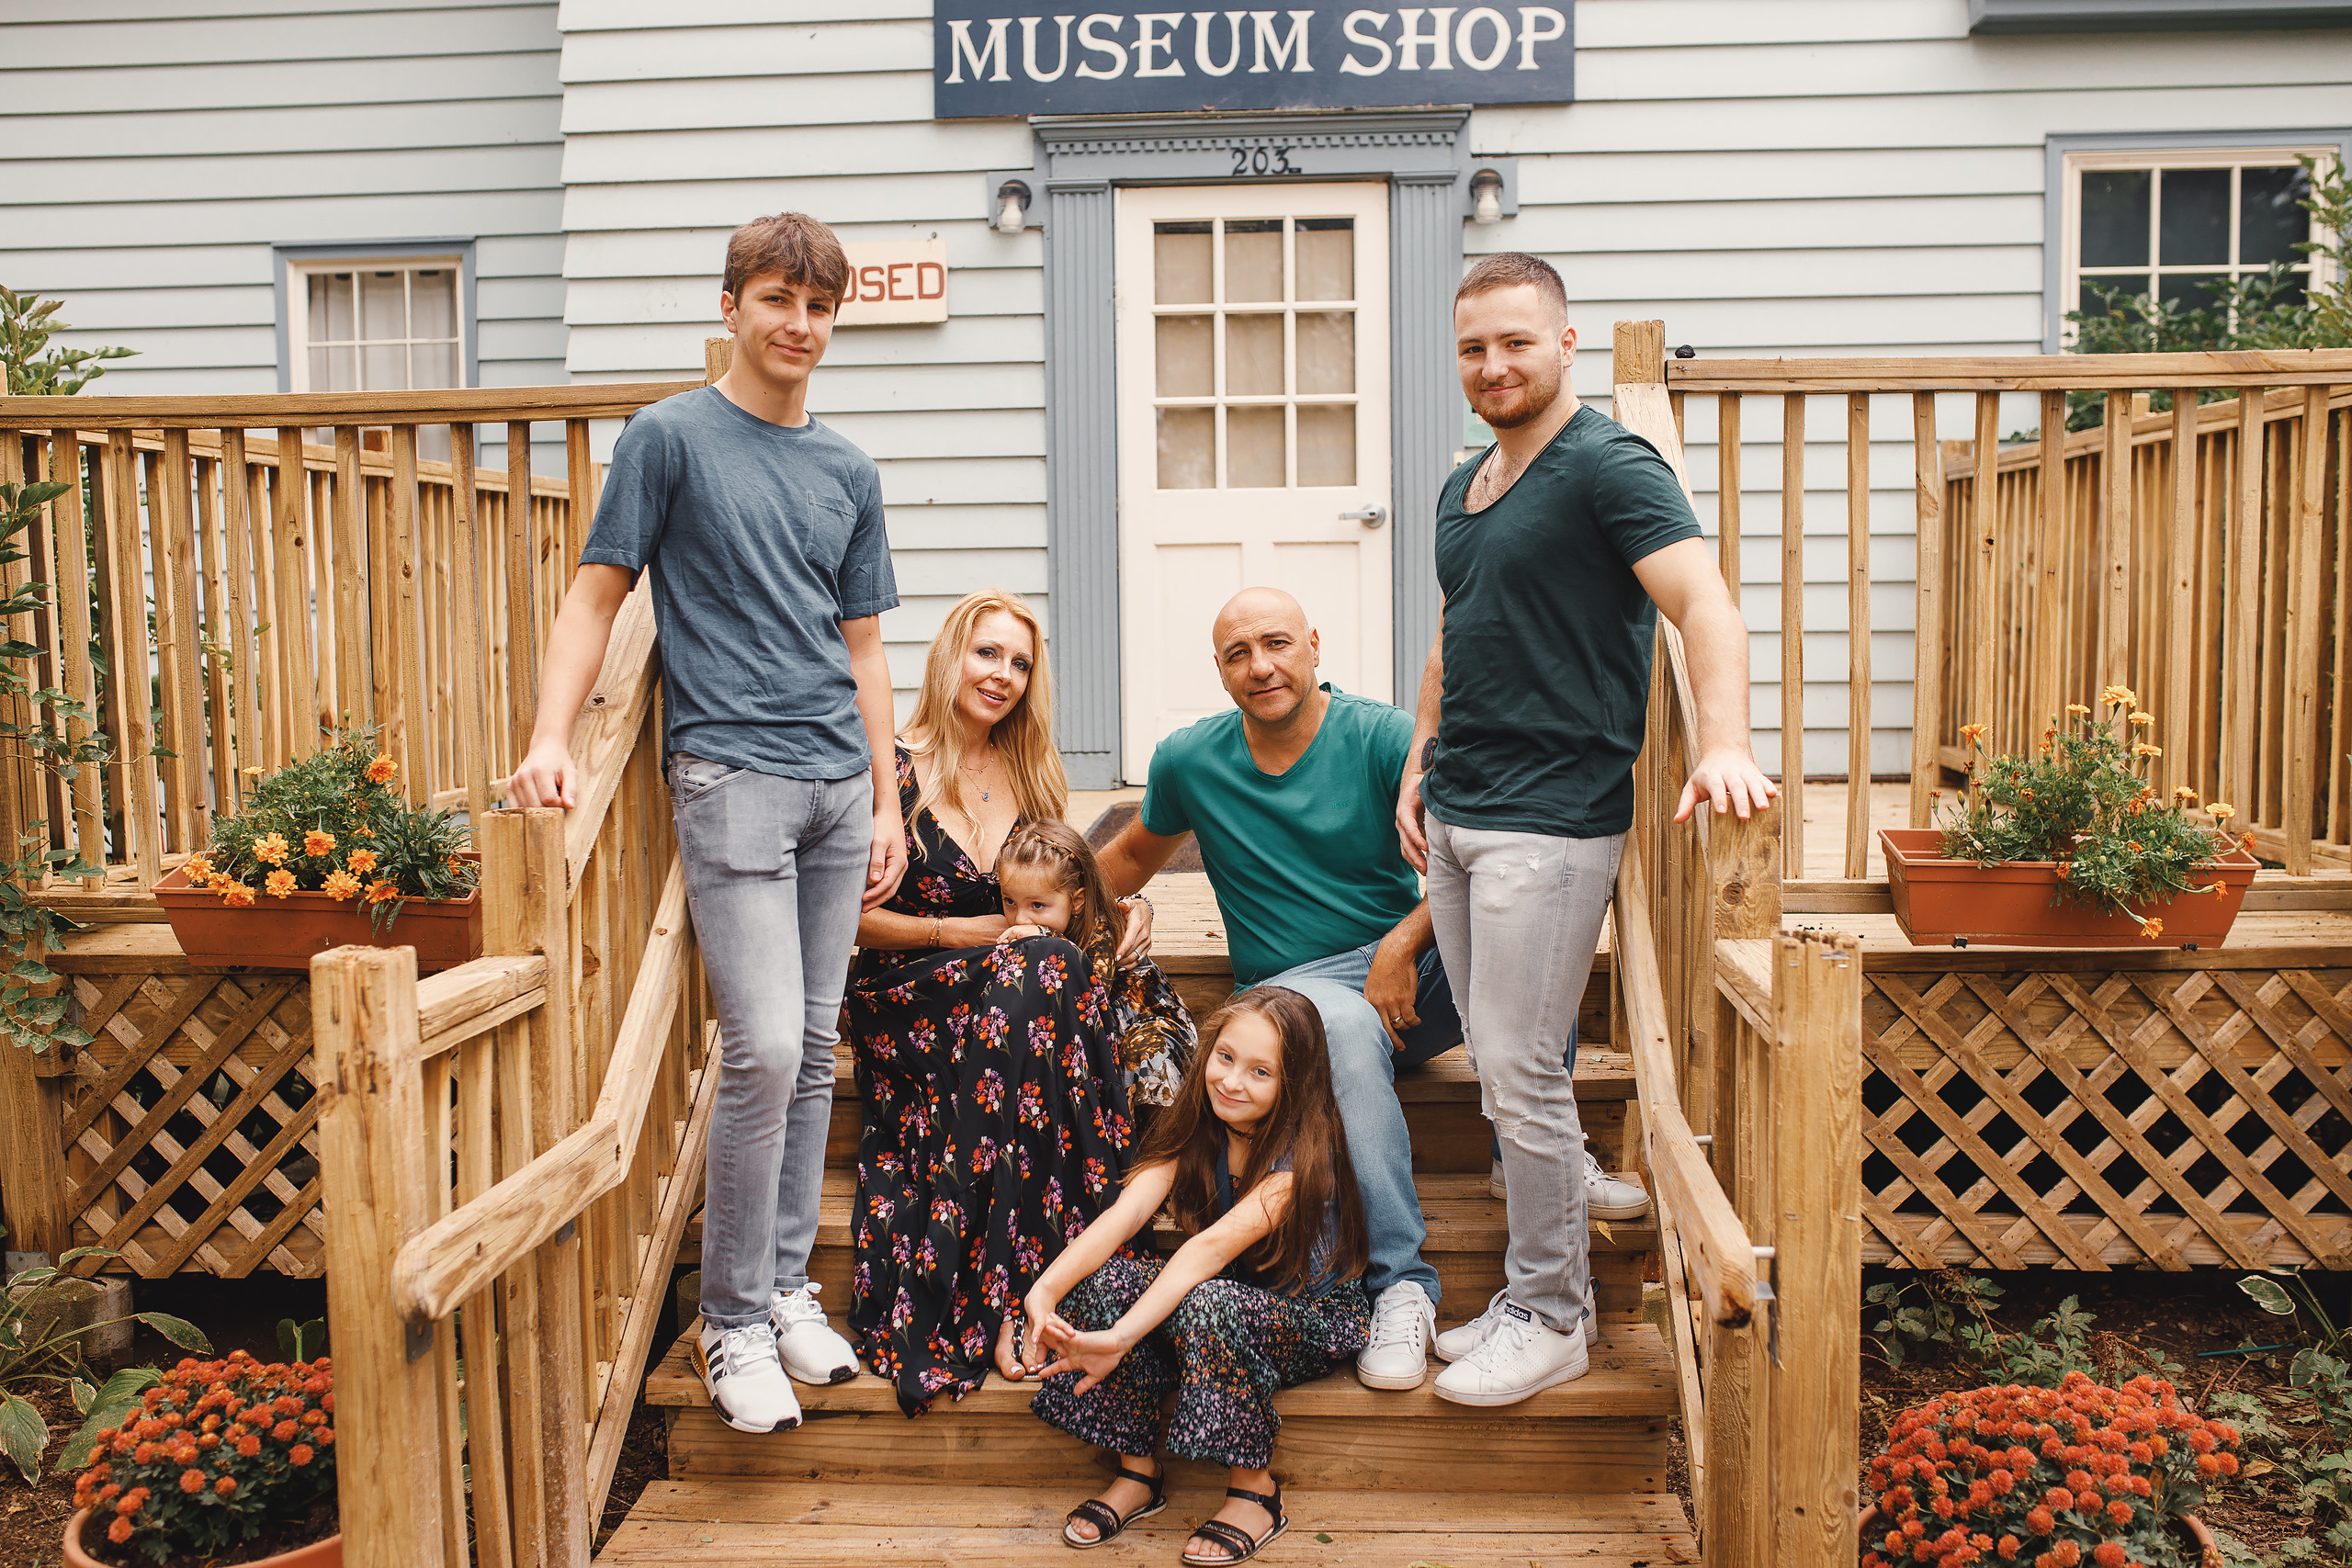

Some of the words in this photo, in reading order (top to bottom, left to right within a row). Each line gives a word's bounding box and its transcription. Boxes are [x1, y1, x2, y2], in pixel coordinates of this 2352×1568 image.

[944, 10, 1316, 85] MUSEUM
[1339, 6, 1566, 77] SHOP
[1231, 146, 1290, 175] 203
